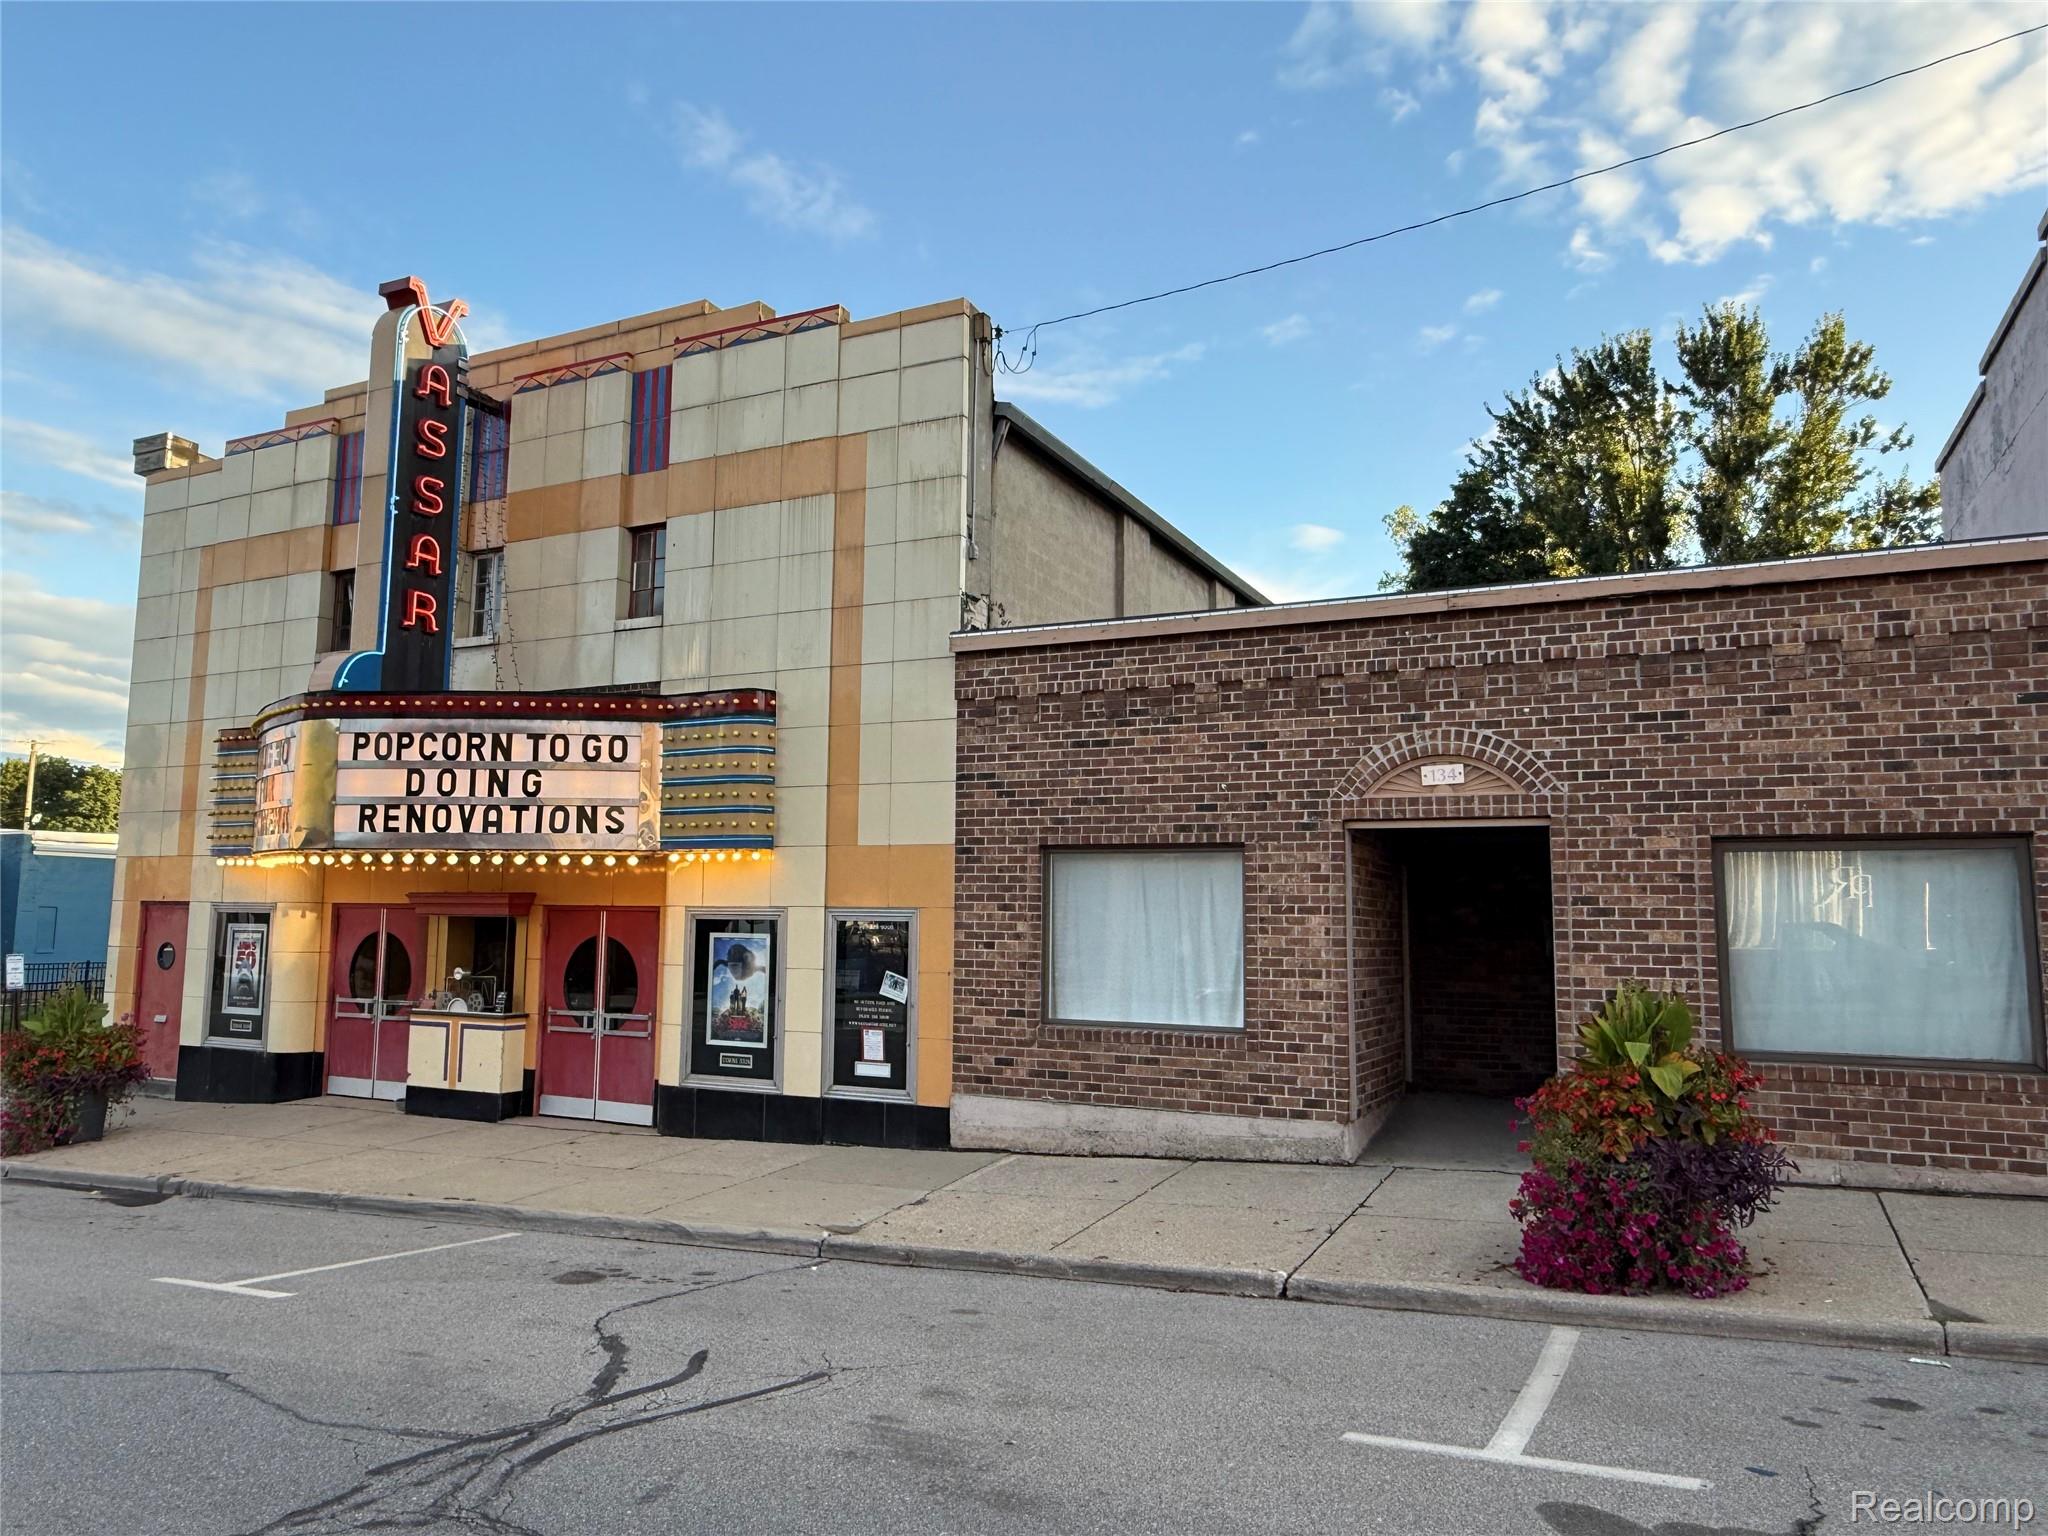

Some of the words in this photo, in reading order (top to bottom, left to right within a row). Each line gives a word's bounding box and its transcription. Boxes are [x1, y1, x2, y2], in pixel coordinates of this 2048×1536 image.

[401, 275, 470, 634] VASSAR
[352, 732, 513, 762] POPCORN
[526, 733, 570, 763] TO
[582, 734, 629, 763] GO
[405, 768, 543, 798] DOING
[1430, 767, 1458, 783] 134
[358, 804, 626, 834] RENOVATIONS
